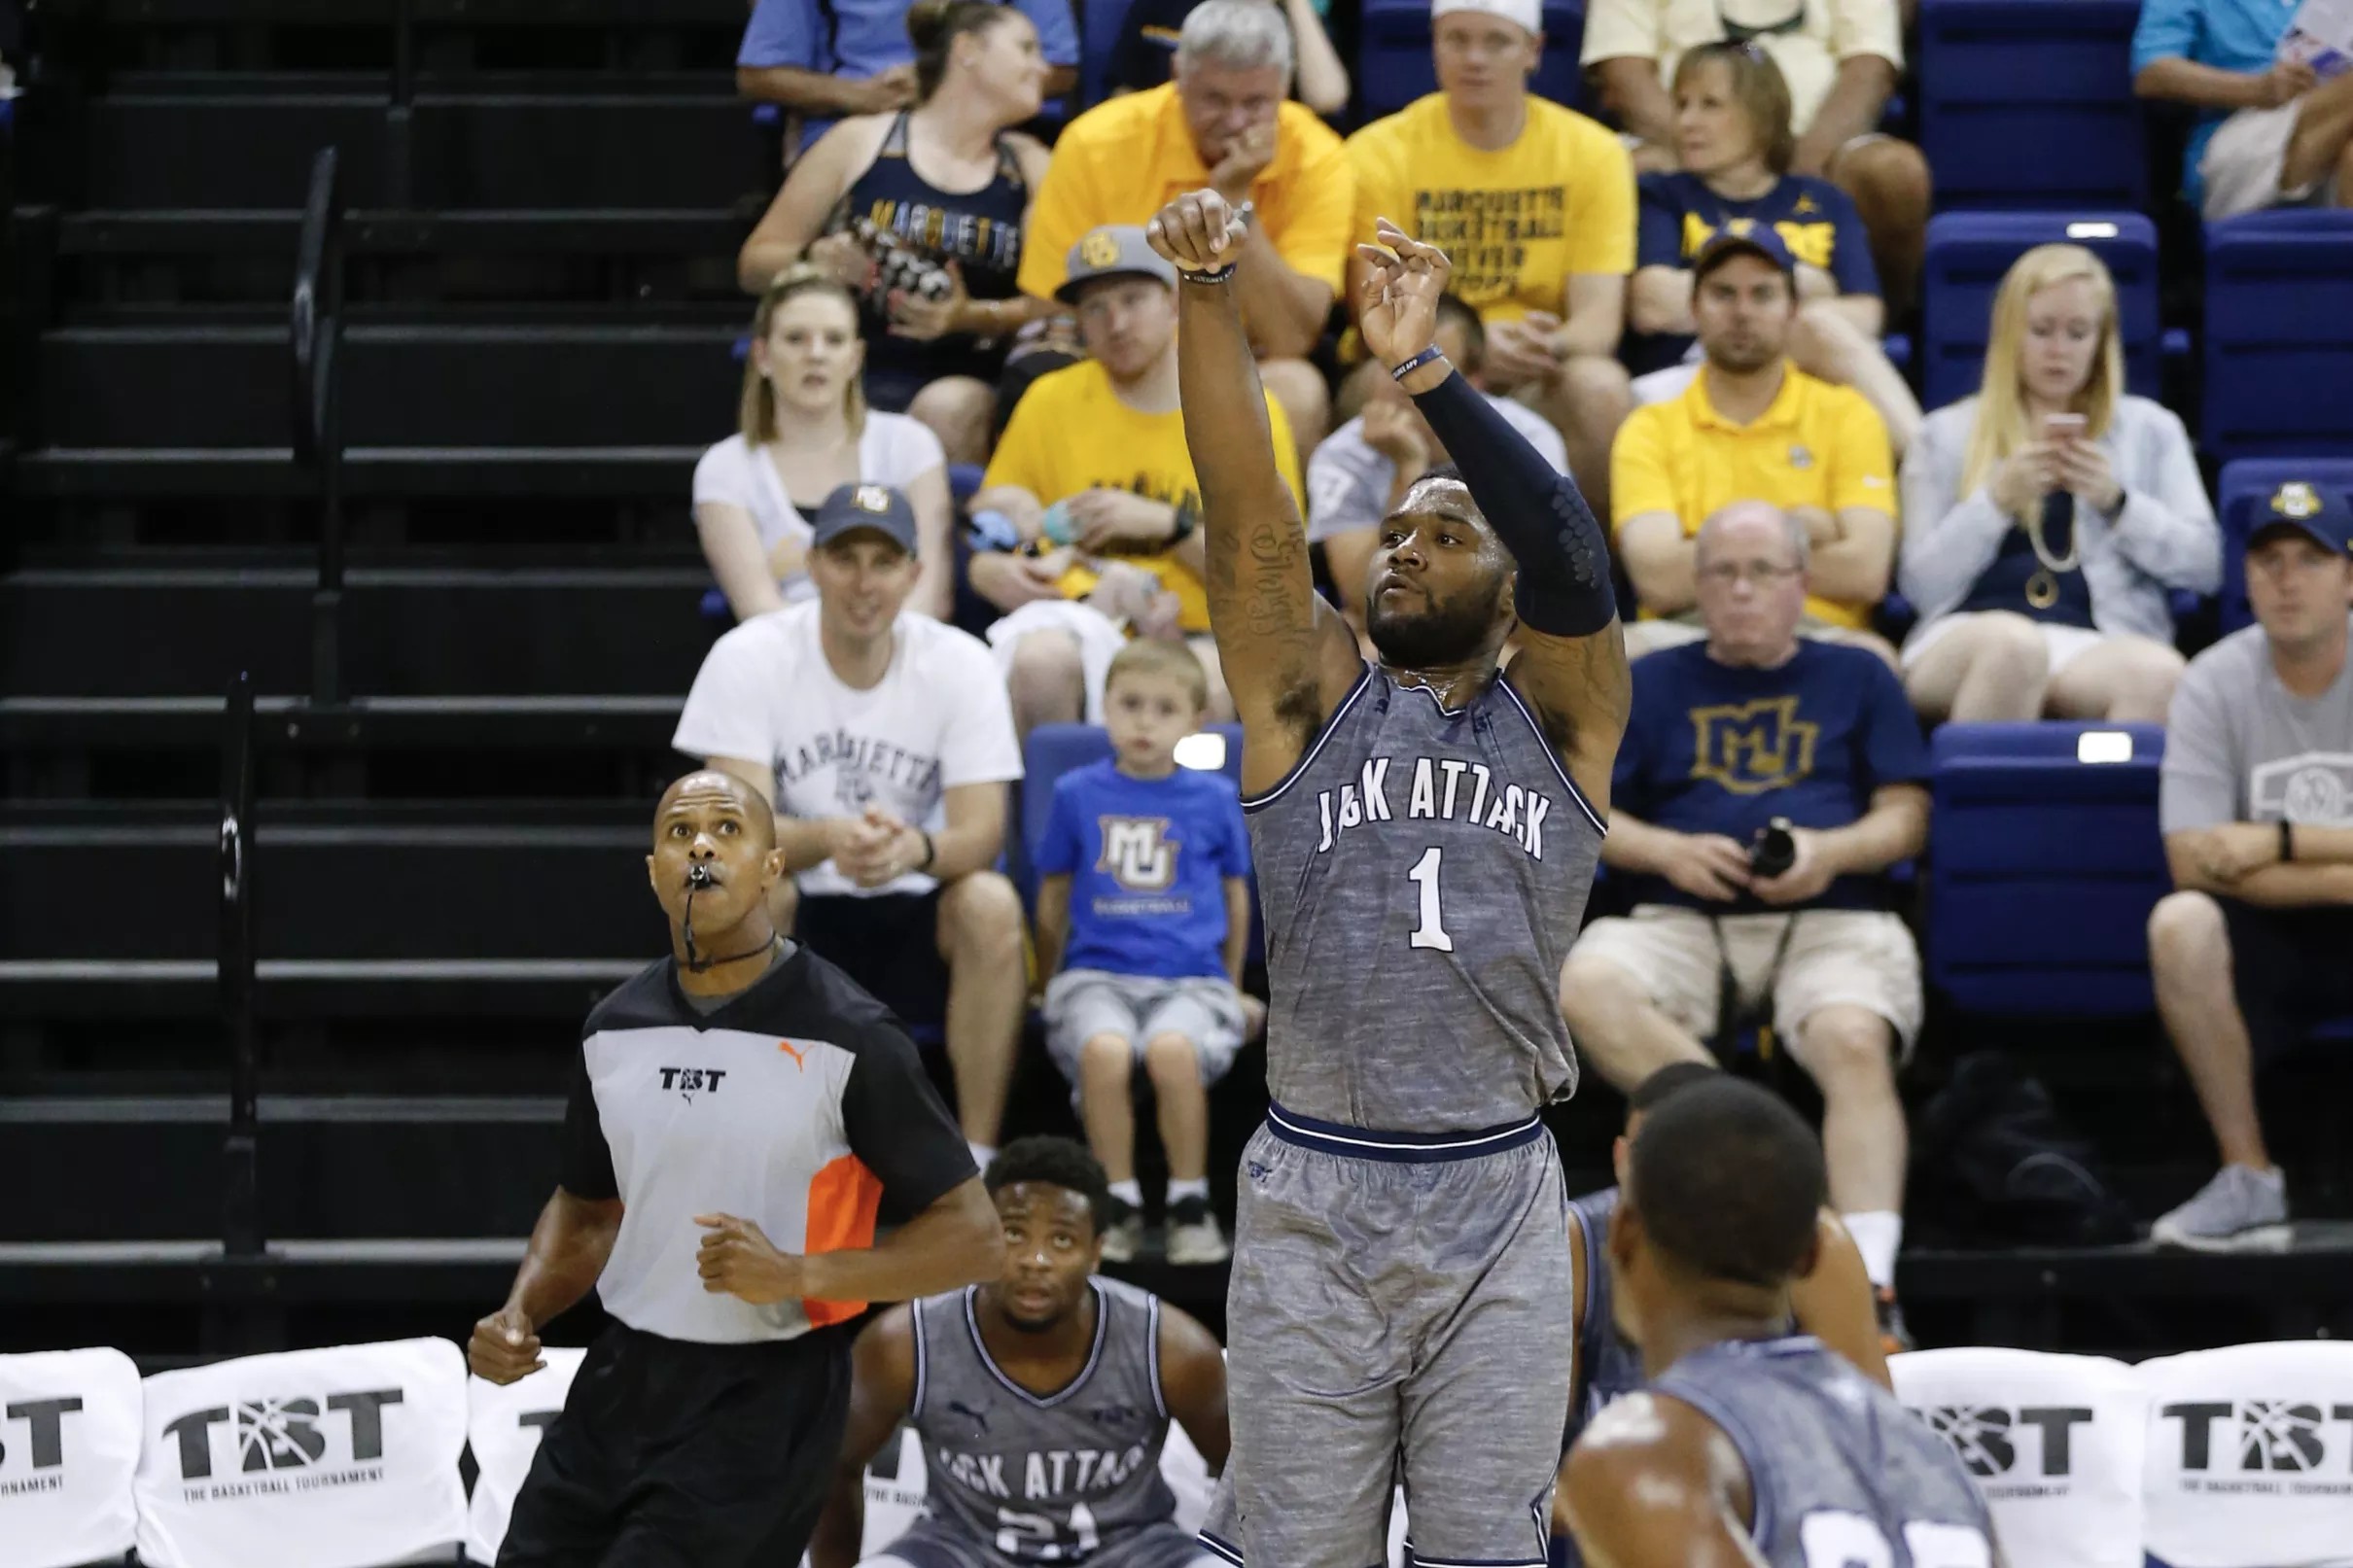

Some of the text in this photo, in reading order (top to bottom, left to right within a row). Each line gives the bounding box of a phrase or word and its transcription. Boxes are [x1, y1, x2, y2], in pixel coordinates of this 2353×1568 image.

[1409, 756, 1552, 861] ATTACK
[1409, 847, 1455, 953] 1
[659, 1067, 726, 1092] TBT
[162, 1388, 404, 1480] TBT
[1913, 1408, 2093, 1476] BT
[183, 1468, 384, 1505] THE BASKETBALL TOURNAMENT
[1025, 1437, 1148, 1501] ATTAC
